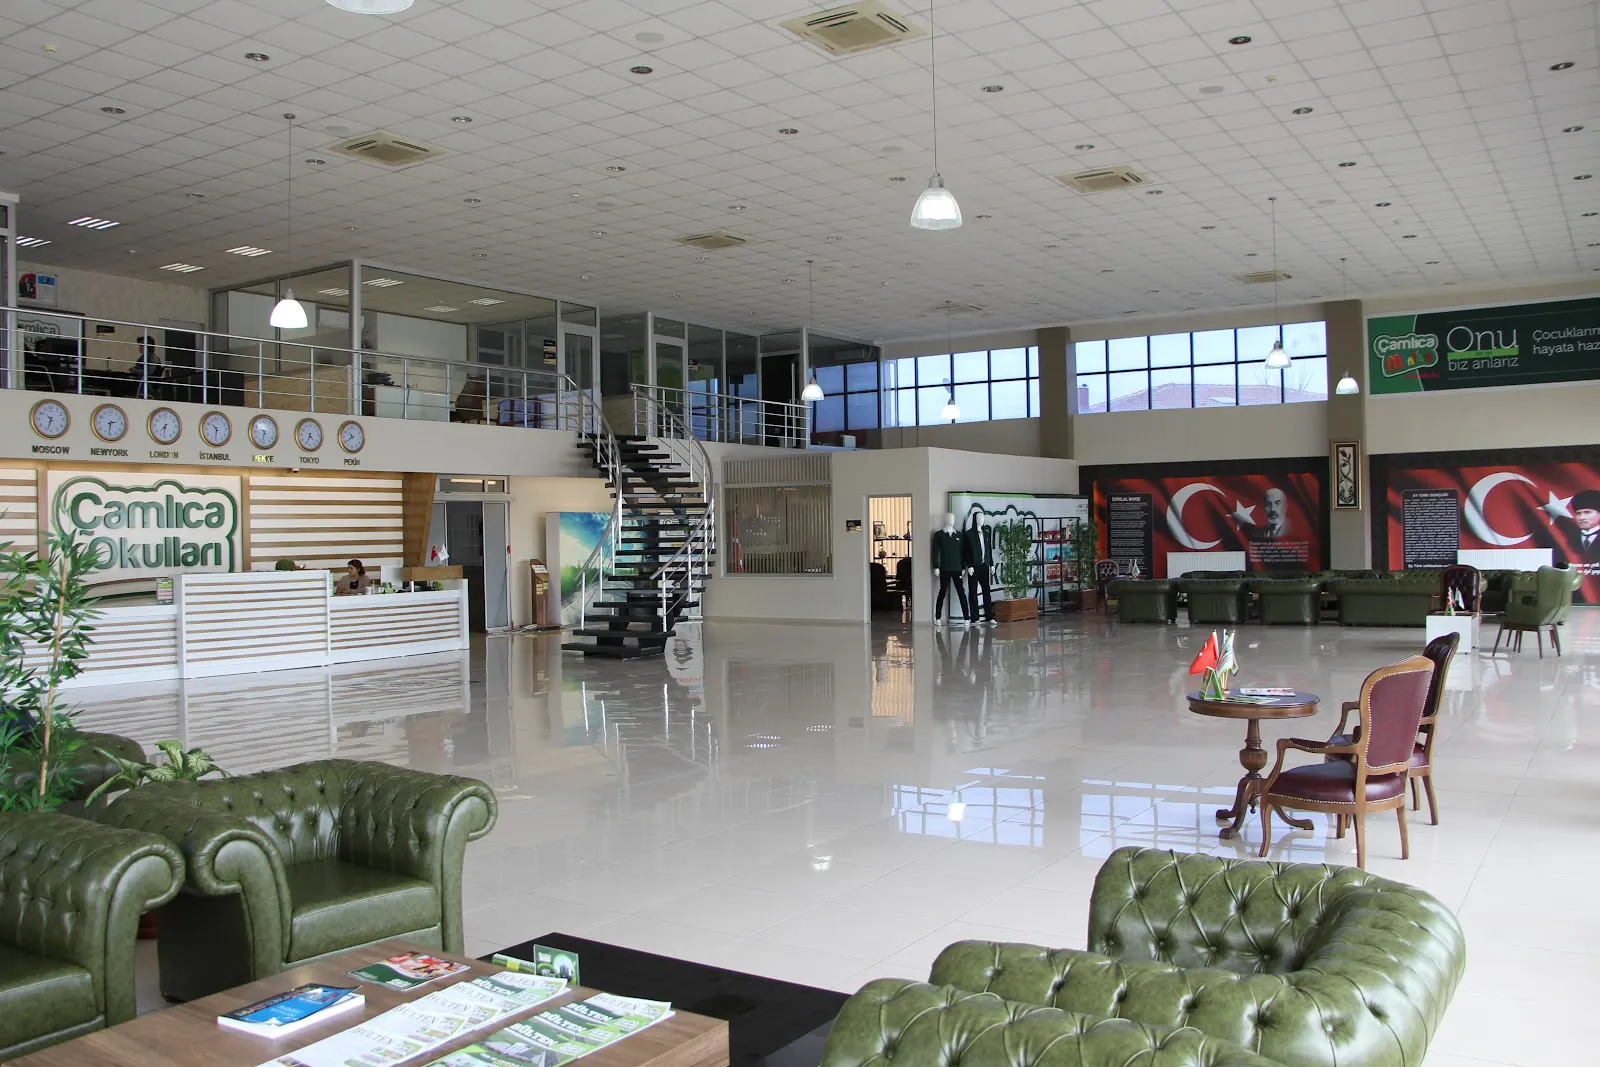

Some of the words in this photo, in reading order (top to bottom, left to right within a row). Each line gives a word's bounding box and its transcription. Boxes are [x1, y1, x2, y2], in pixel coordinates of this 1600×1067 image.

[1378, 337, 1435, 353] Çamlıca
[1446, 326, 1519, 353] Onu
[1532, 342, 1575, 356] hayata
[1448, 358, 1469, 371] biz
[1472, 356, 1519, 370] anlarız
[32, 445, 70, 454] MOSCOW
[90, 448, 129, 457] NEWYORK
[149, 451, 179, 459] LONDON
[199, 450, 231, 461] İSTANBUL
[299, 456, 320, 464] TOKYO
[87, 536, 222, 569] Okulları
[397, 1003, 440, 1025] BÜLTEN
[566, 1002, 613, 1022] BÜLTEN
[539, 1011, 588, 1033] BÜLTEN
[350, 1026, 395, 1046] BÜLTEN
[509, 1023, 560, 1046] BÜLTEN
